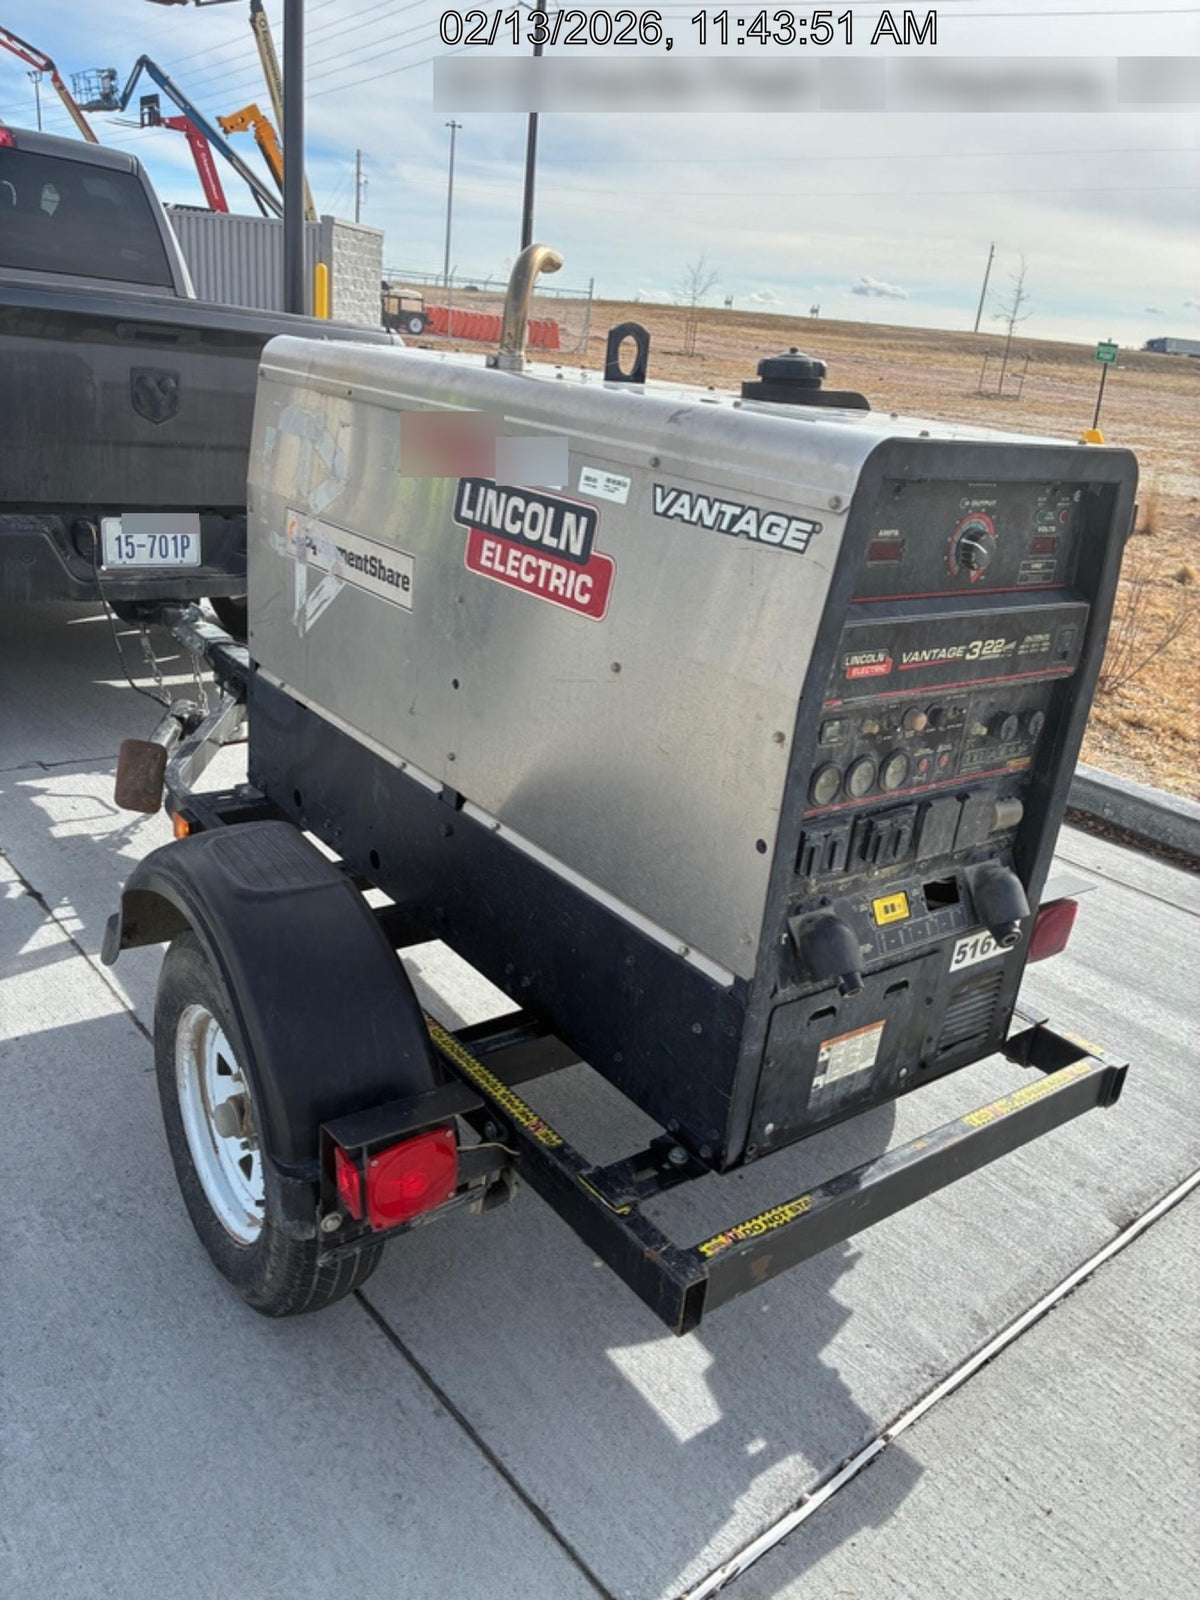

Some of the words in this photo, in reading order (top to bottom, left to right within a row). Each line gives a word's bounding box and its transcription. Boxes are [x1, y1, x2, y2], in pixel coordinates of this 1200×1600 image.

[459, 482, 589, 557] LINCOLN
[114, 534, 191, 559] 15-701P
[479, 538, 594, 605] ELECTRIC
[845, 651, 887, 666] LINCOLN
[902, 645, 966, 664] VANTAGE
[965, 638, 1006, 660] 322
[851, 664, 888, 676] ELECTRIC
[954, 935, 998, 964] 516
[741, 1222, 763, 1236] DO
